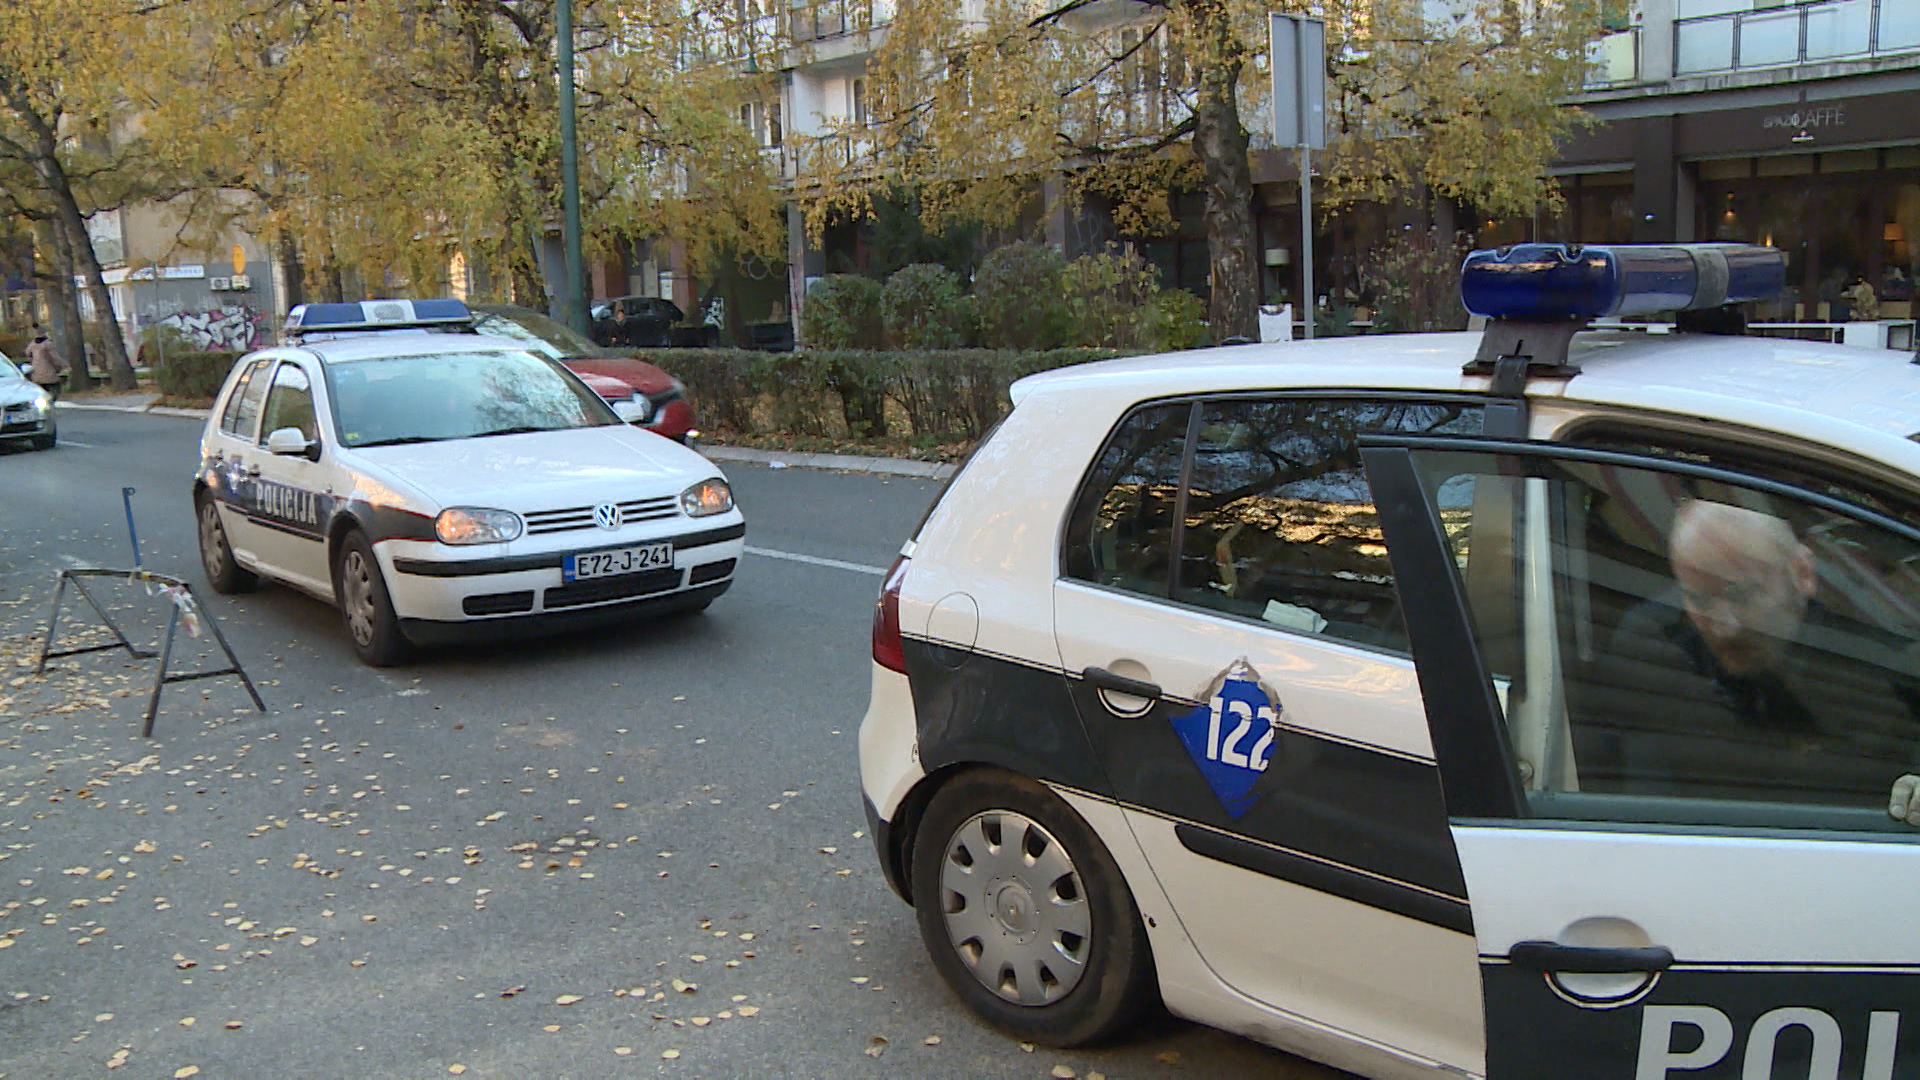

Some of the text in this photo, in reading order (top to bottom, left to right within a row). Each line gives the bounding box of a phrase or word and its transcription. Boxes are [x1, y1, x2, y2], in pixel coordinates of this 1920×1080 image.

[255, 481, 318, 526] POLICIJA
[577, 545, 670, 577] E72-J-241
[1206, 695, 1275, 772] 122
